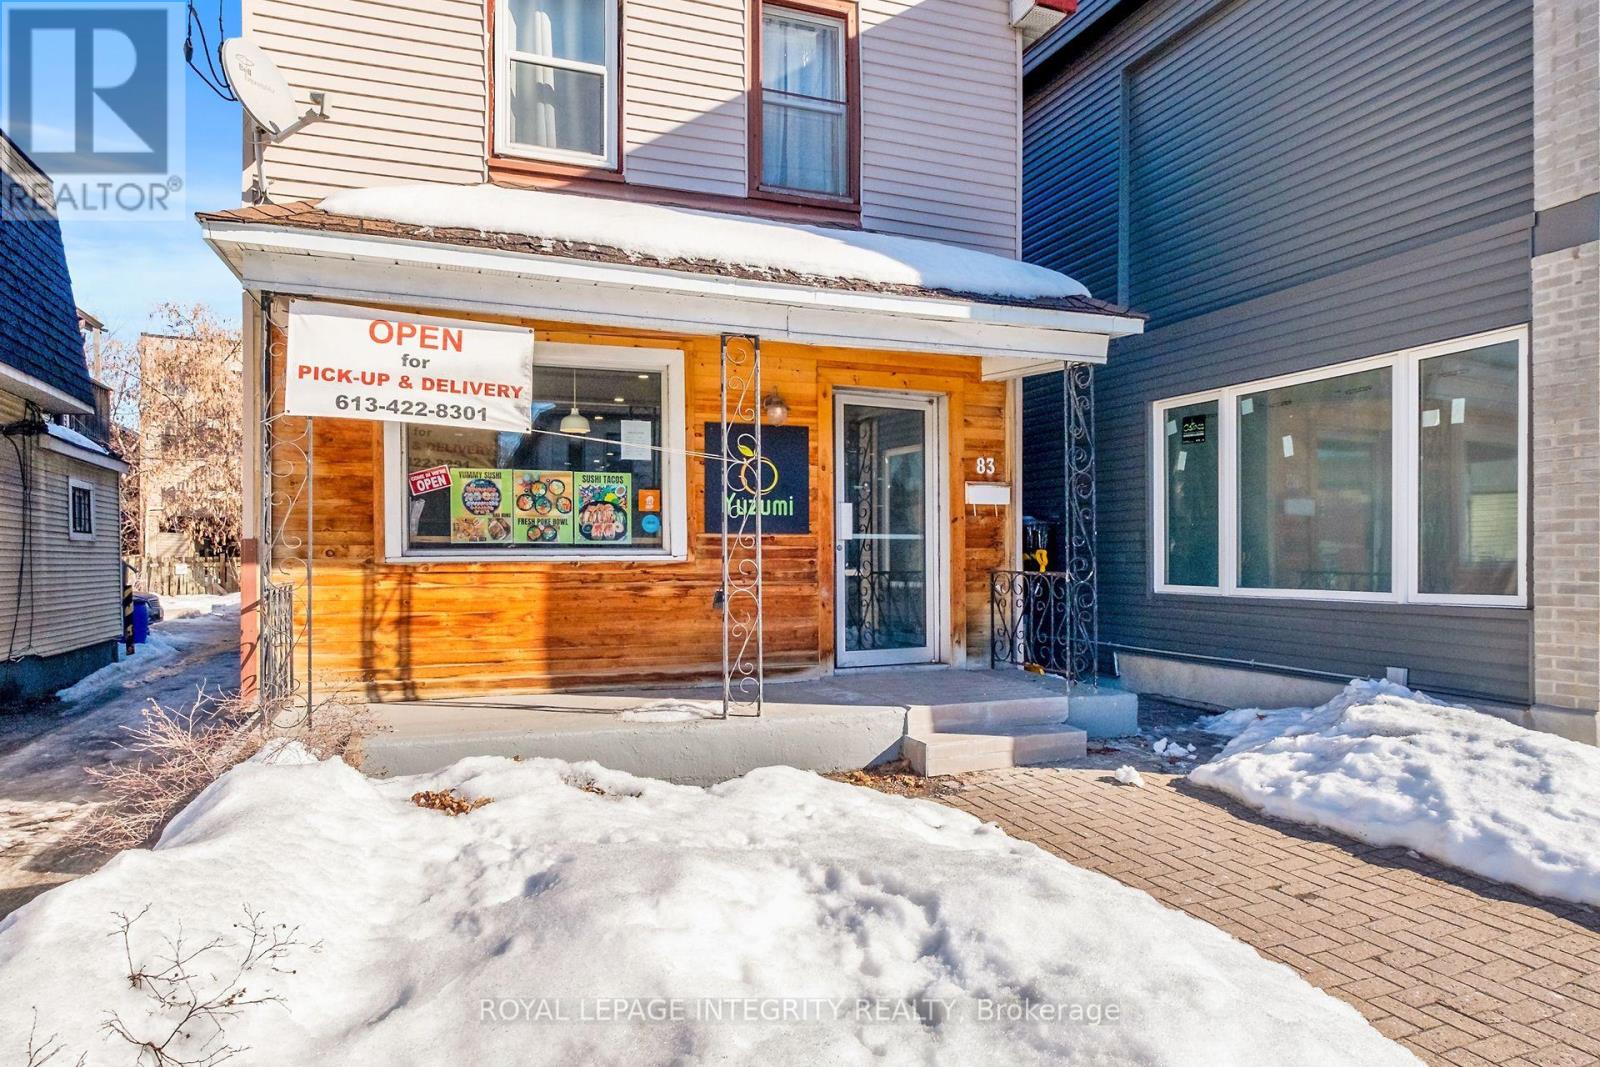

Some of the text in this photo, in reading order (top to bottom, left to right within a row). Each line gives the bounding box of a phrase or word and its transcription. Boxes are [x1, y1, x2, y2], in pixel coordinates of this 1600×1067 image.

[369, 319, 464, 352] OPEN
[401, 353, 431, 369] for
[298, 365, 524, 399] PICK-UP & DELIVERY
[335, 394, 488, 422] 613-422-8301
[459, 471, 482, 479] YUMMY
[976, 457, 996, 475] 83
[416, 473, 447, 491] OPEN
[582, 474, 624, 484] SUSHI TACOS
[725, 492, 794, 516] Yuzumi
[518, 518, 535, 526] FRESH
[552, 518, 568, 526] BOWL
